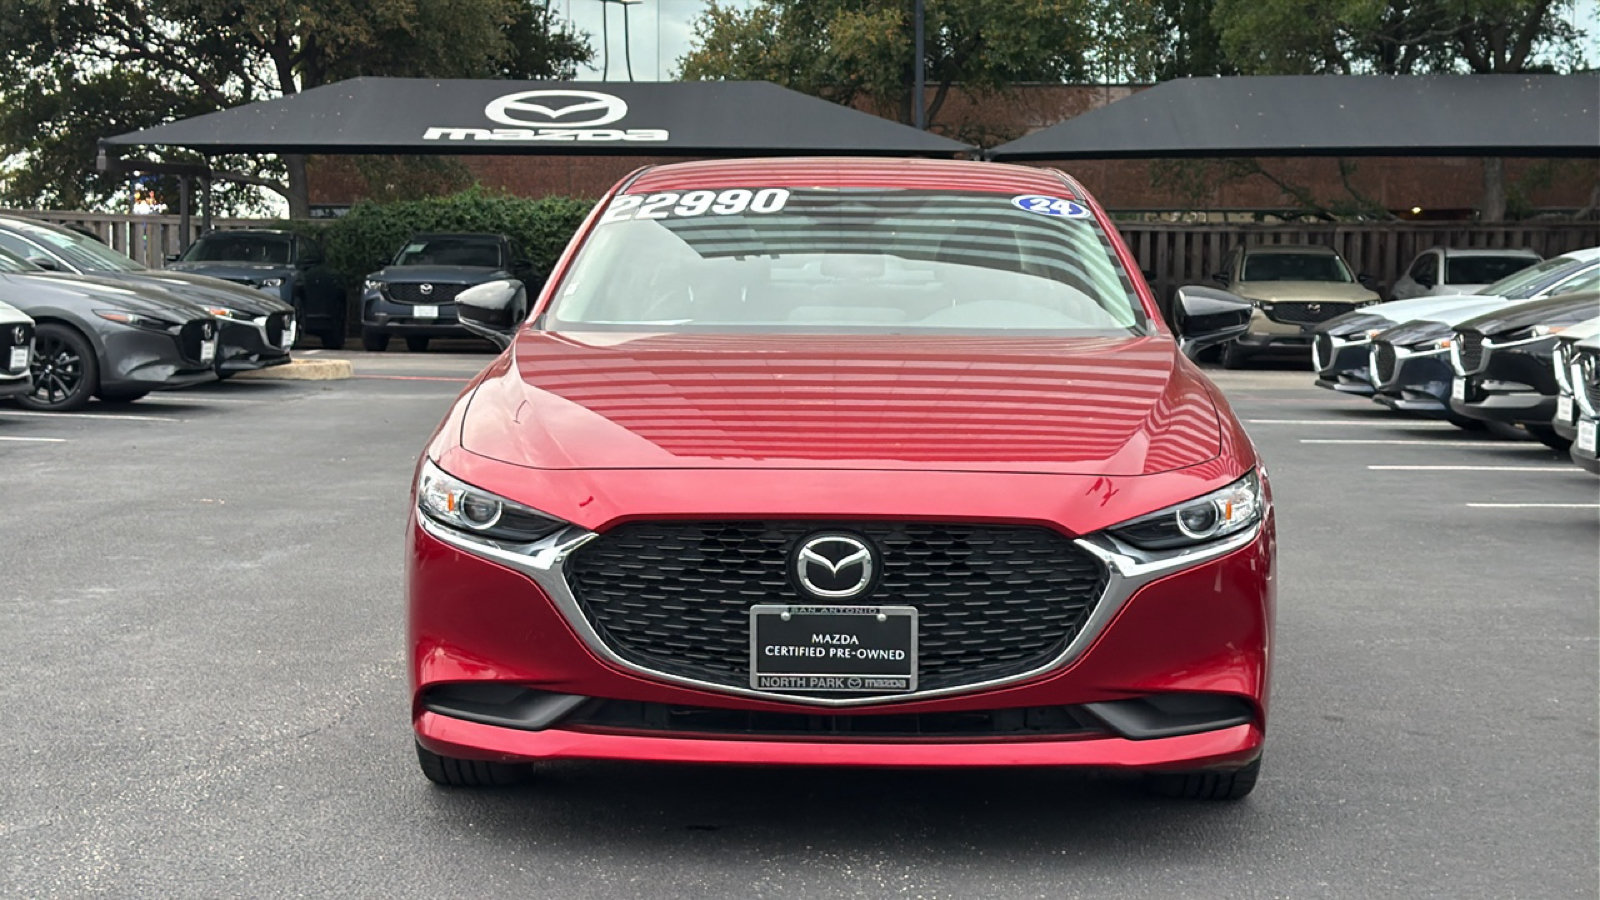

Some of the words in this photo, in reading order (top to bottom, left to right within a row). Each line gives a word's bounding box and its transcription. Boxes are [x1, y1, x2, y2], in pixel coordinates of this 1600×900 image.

[602, 188, 790, 221] 22990
[1029, 199, 1074, 215] 24
[820, 607, 877, 615] ANTONIO
[811, 633, 859, 645] MAZDA
[765, 645, 825, 658] CERTIFIED
[829, 648, 905, 660] PRE-OWNED
[760, 676, 806, 688] NORTH
[809, 678, 845, 688] PARK
